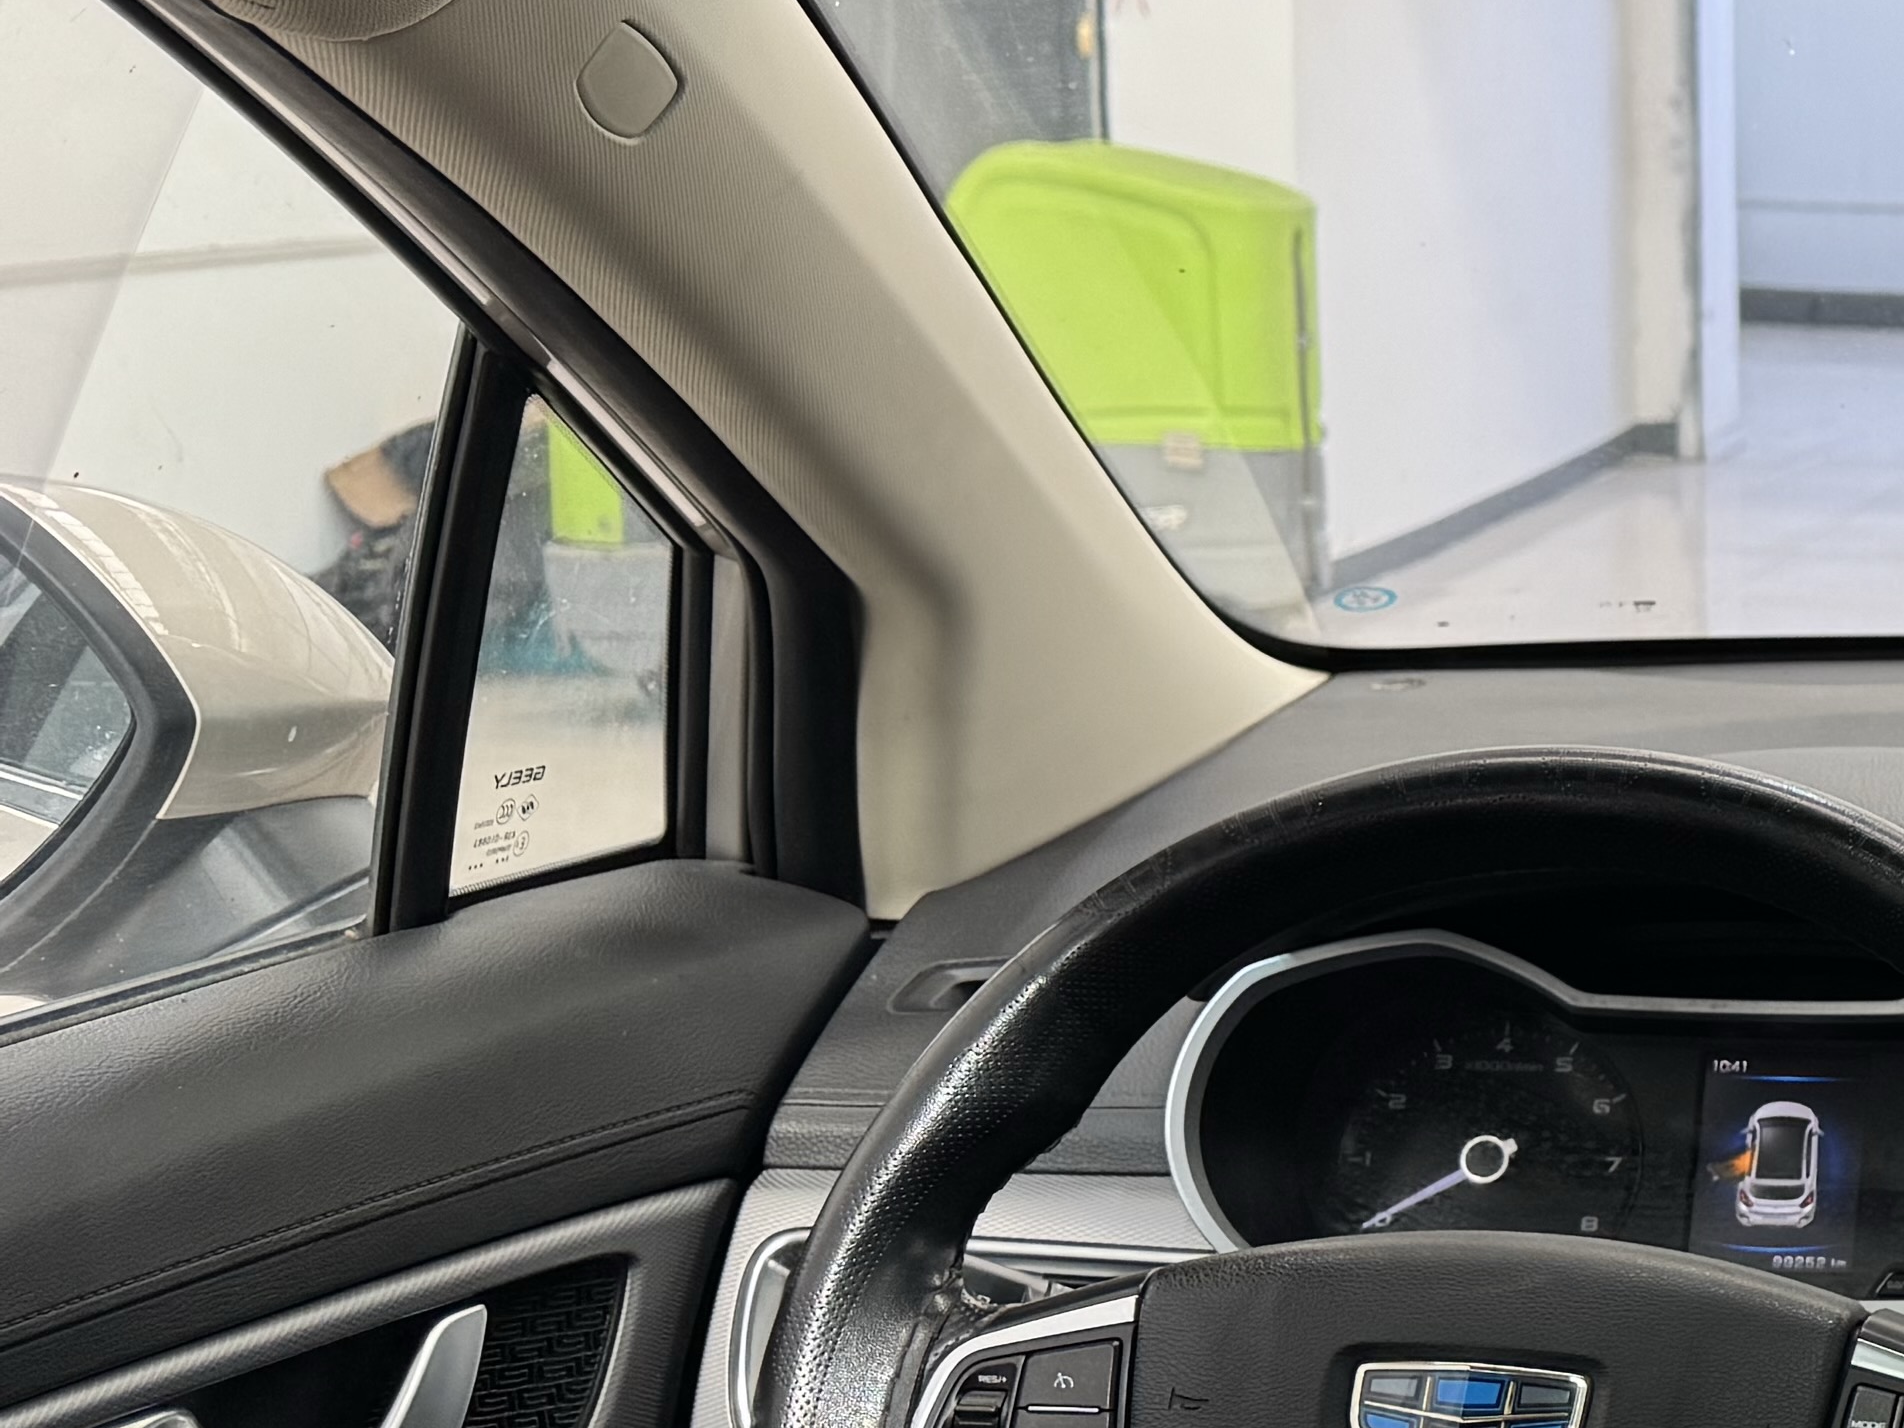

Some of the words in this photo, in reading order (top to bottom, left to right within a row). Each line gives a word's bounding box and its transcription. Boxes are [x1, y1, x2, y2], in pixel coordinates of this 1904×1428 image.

[1496, 1036, 1515, 1053] 4
[1435, 1054, 1454, 1070] 3
[1555, 1056, 1574, 1073] 5
[1712, 1059, 1748, 1073] 10:41
[1388, 1094, 1406, 1110] 2
[1593, 1098, 1611, 1115] 6
[1606, 1157, 1623, 1173] 7
[1580, 1216, 1599, 1232] 8
